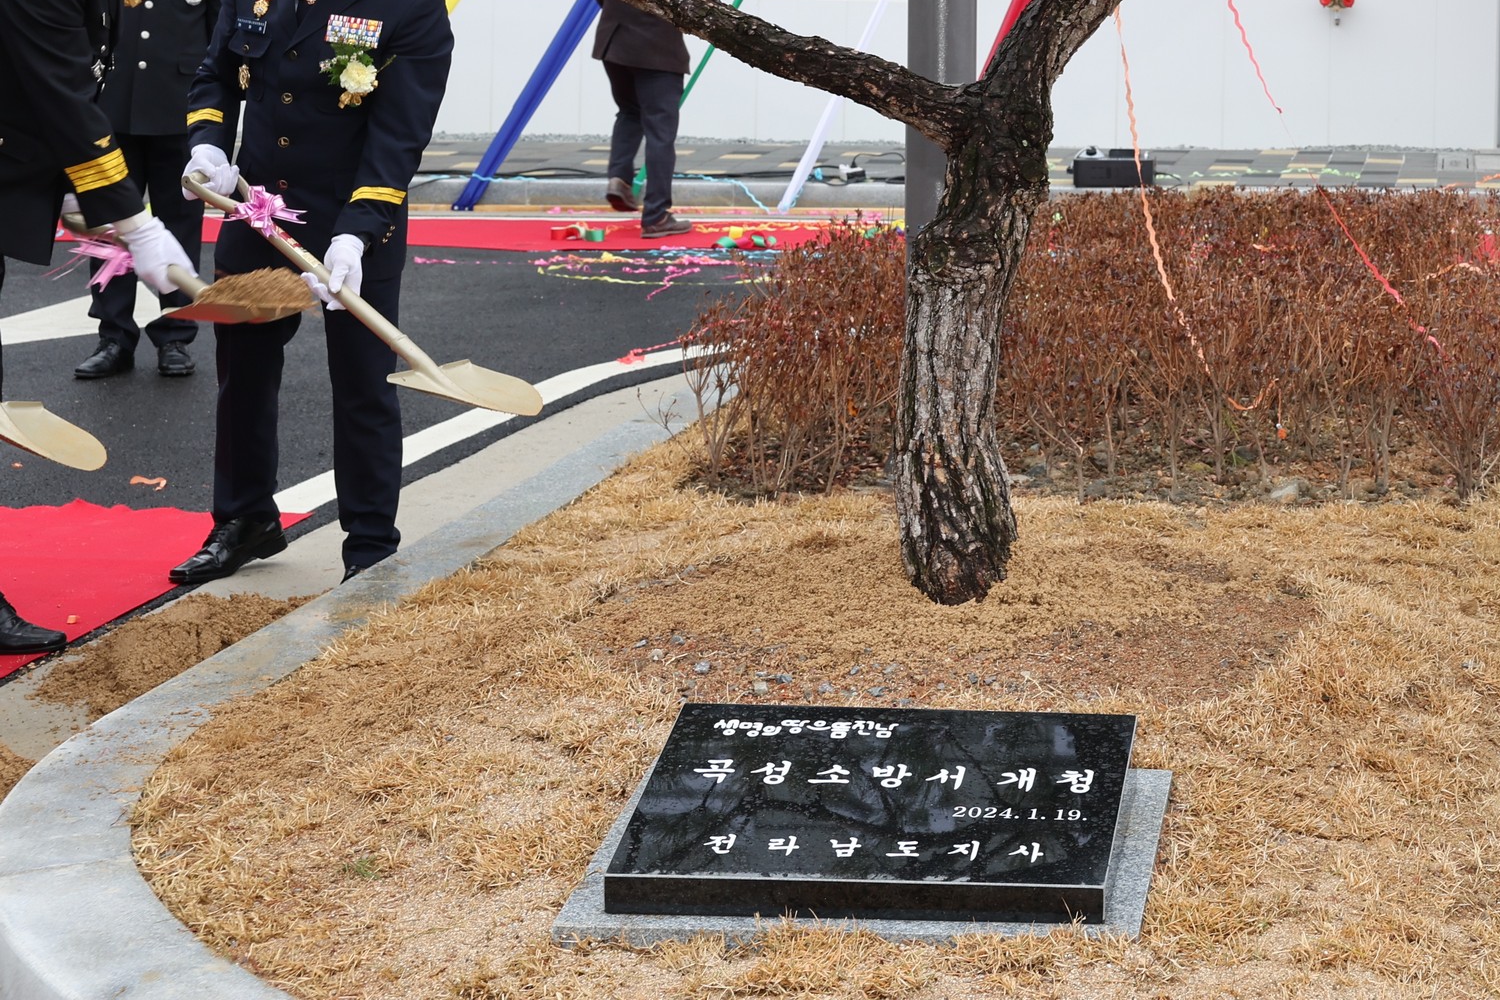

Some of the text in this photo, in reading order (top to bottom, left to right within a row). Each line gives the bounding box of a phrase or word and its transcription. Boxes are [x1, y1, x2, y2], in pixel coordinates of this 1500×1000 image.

[997, 767, 1095, 794] 개청
[952, 806, 1088, 821] 2024. 1. 19.
